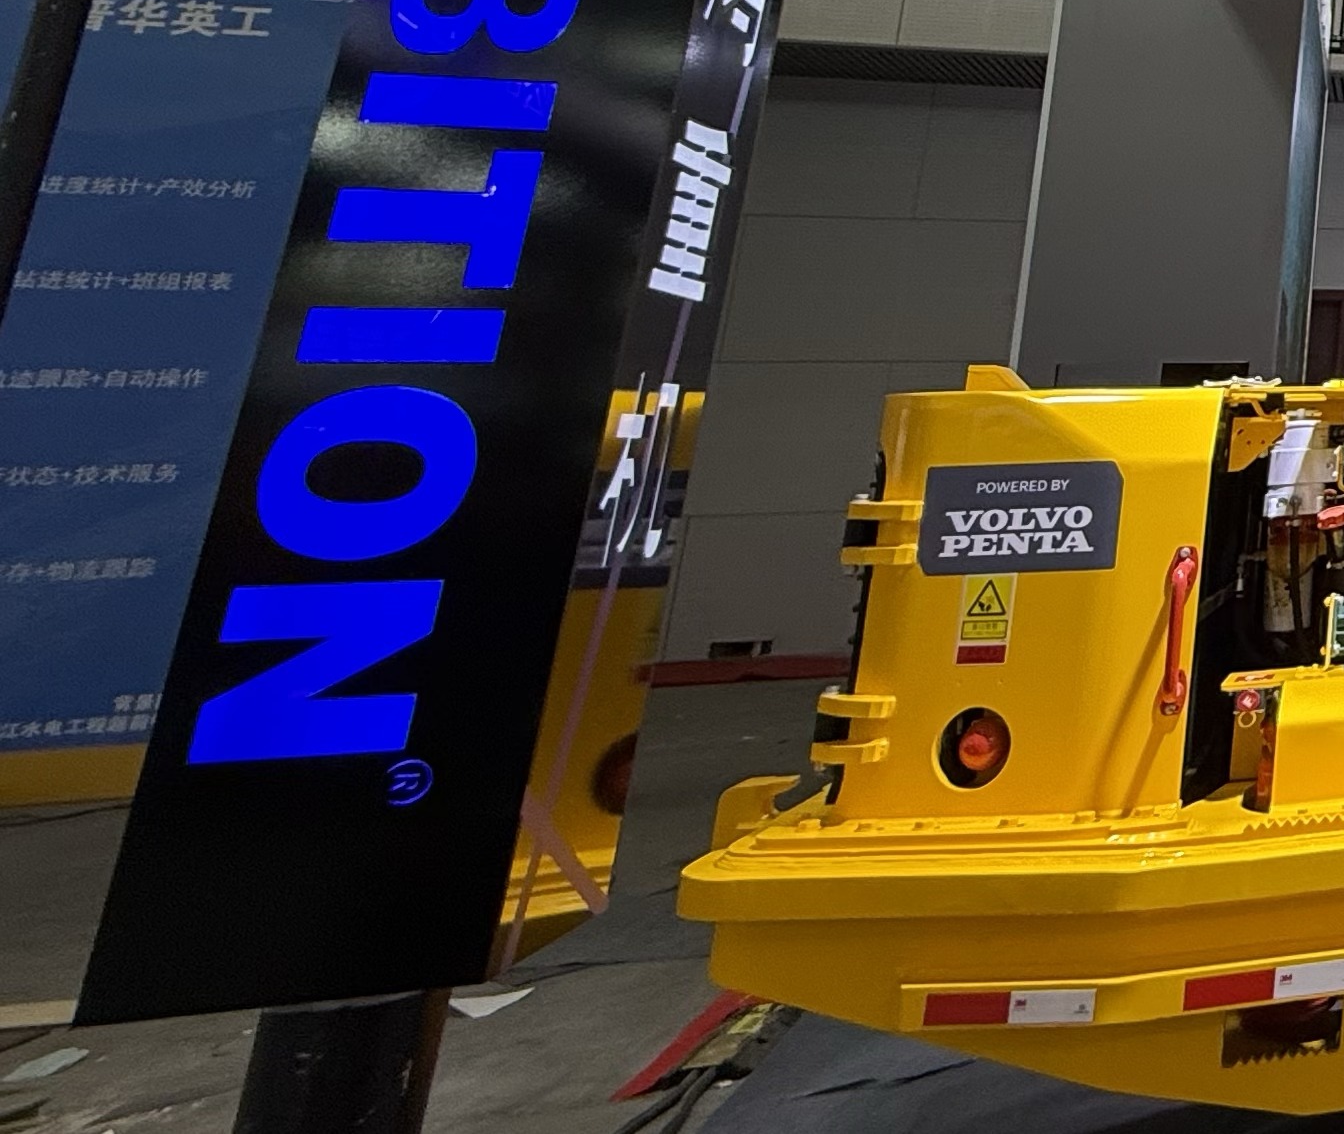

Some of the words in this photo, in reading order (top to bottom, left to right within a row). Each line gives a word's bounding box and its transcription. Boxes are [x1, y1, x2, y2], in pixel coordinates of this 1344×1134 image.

[976, 479, 1048, 494] POWERED
[1050, 478, 1071, 492] BY
[945, 506, 1093, 533] VOLVO
[938, 530, 1094, 558] PENTA
